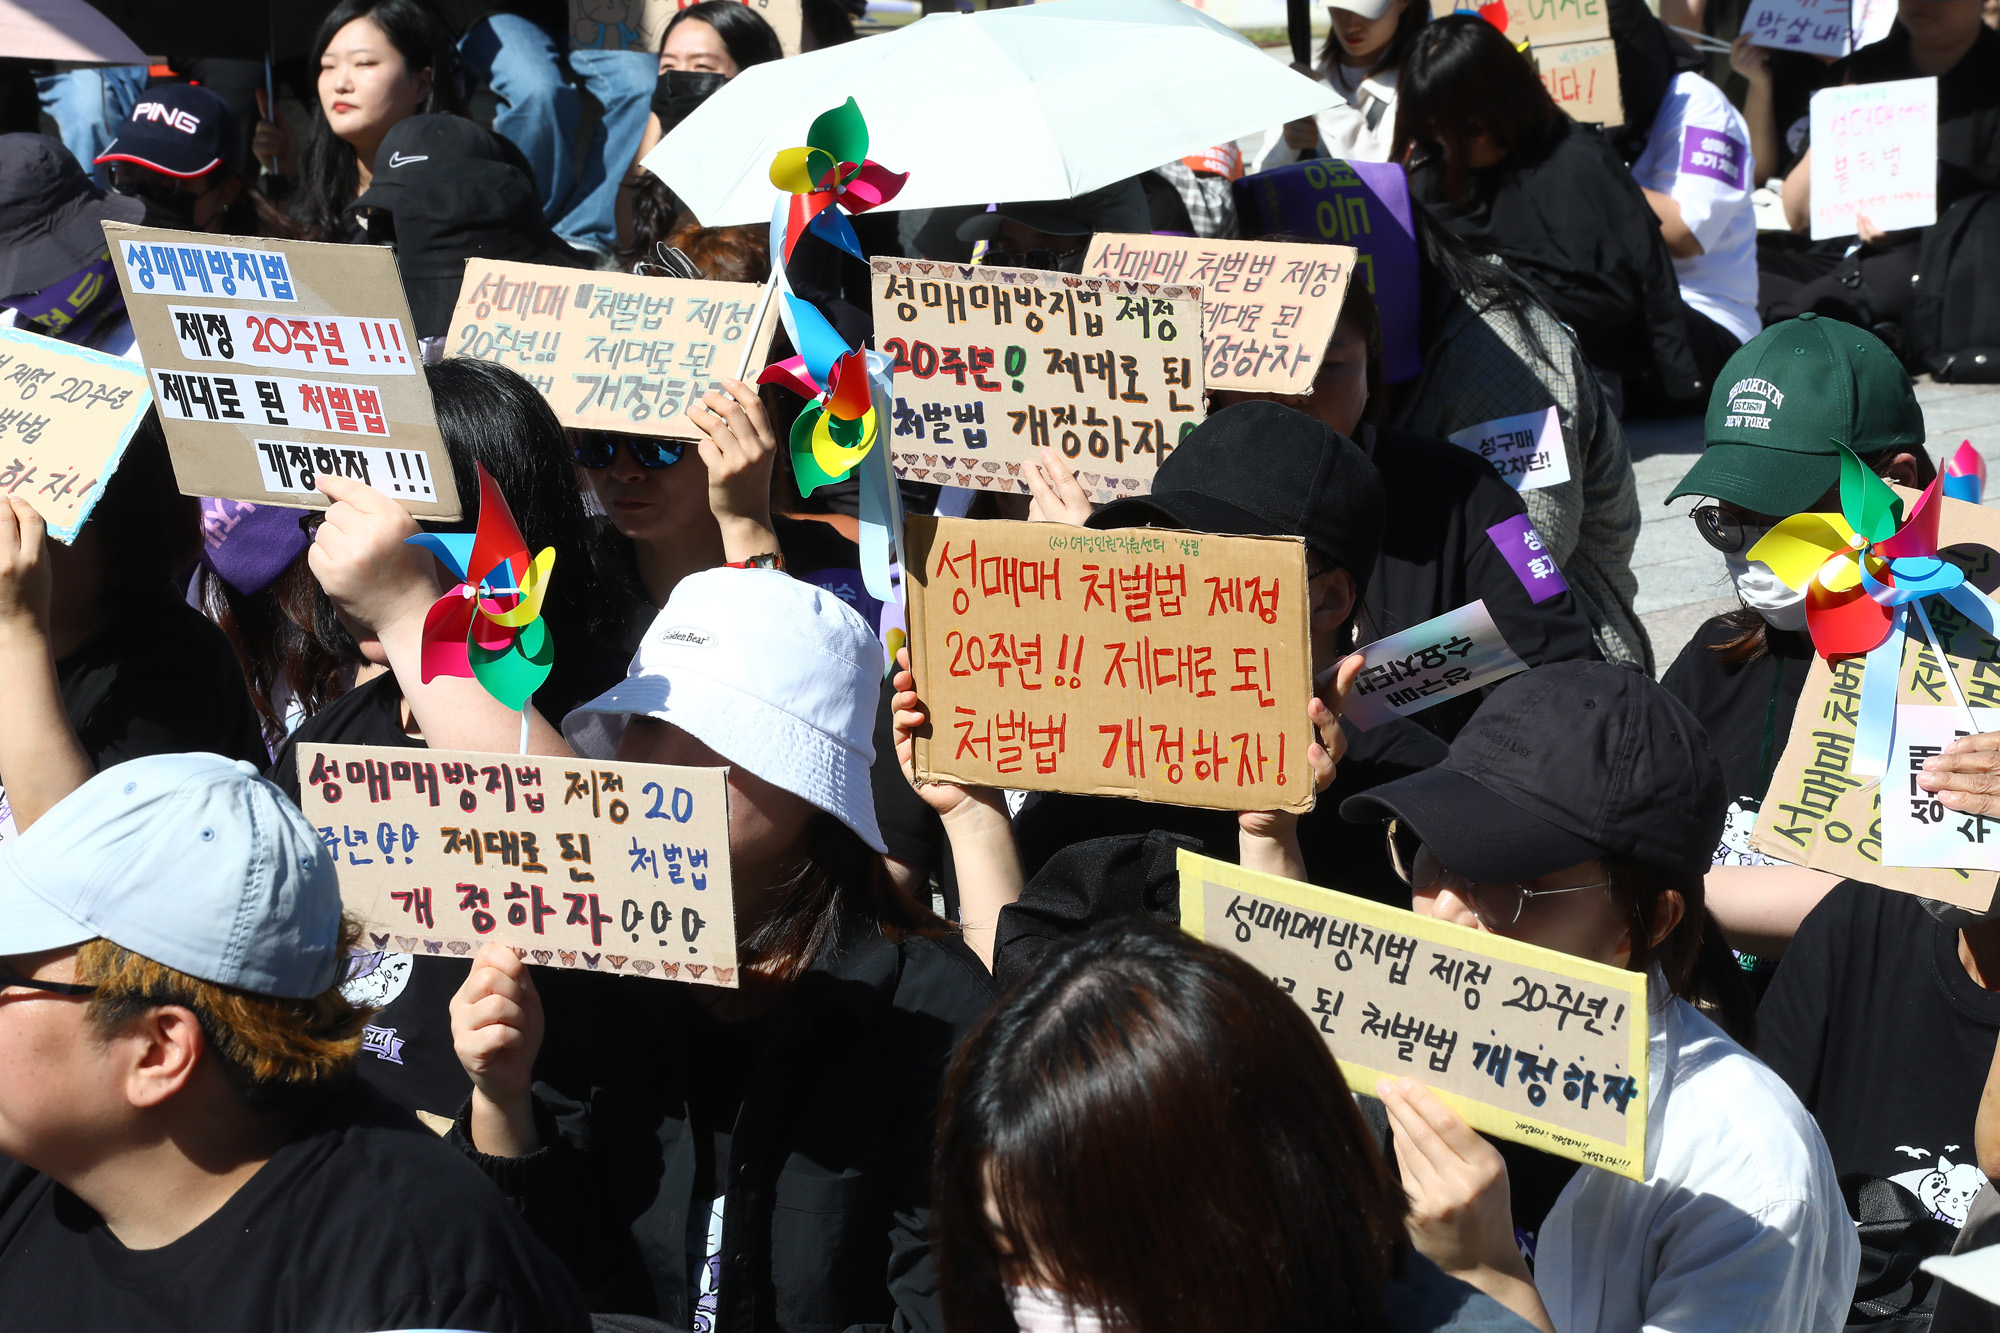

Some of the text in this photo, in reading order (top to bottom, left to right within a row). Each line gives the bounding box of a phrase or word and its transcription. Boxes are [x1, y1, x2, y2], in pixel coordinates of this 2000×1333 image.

[132, 102, 200, 135] PING
[127, 243, 294, 300] 성매매방지법
[1092, 242, 1187, 284] 성매매
[1189, 251, 1276, 294] 처벌법
[1280, 260, 1342, 298] 제정
[468, 271, 756, 343] 성매매 처벌법 제정
[884, 273, 1178, 343] 성매매방지법 제정
[1271, 304, 1303, 339] 된
[175, 312, 234, 360] 제정
[246, 315, 349, 366] 20주년
[584, 335, 674, 376] 제대로
[679, 342, 718, 379] 된
[4, 363, 133, 410] 제정 20주년
[158, 373, 387, 435] 제대로 된 처벌법
[1043, 347, 1149, 405] 제대로
[1162, 356, 1196, 413] 된
[1726, 378, 1784, 410] BROOKLYN
[892, 397, 988, 450] 처벌법
[1479, 429, 1535, 456] 성구매
[1724, 415, 1772, 430] NEW YORK
[258, 443, 371, 491] 개정하자
[935, 539, 1280, 624] 성매매 처벌법 제정
[662, 630, 686, 642] Golden
[1104, 635, 1217, 698] 제대로
[1230, 646, 1276, 707] 된
[1385, 666, 1473, 707] 성구매
[953, 706, 1287, 787] 처벌법 개정하자!
[308, 752, 694, 825] 성매매방지법 제정 20
[1773, 731, 1863, 847] 성매매
[440, 826, 548, 874] 제대로
[556, 831, 596, 883] 된
[628, 836, 709, 891] 처벌법
[1225, 894, 1418, 985] 성매매방지법
[1429, 951, 1493, 1011] 제정
[1311, 986, 1639, 1115] 된 처벌법 개정하자
